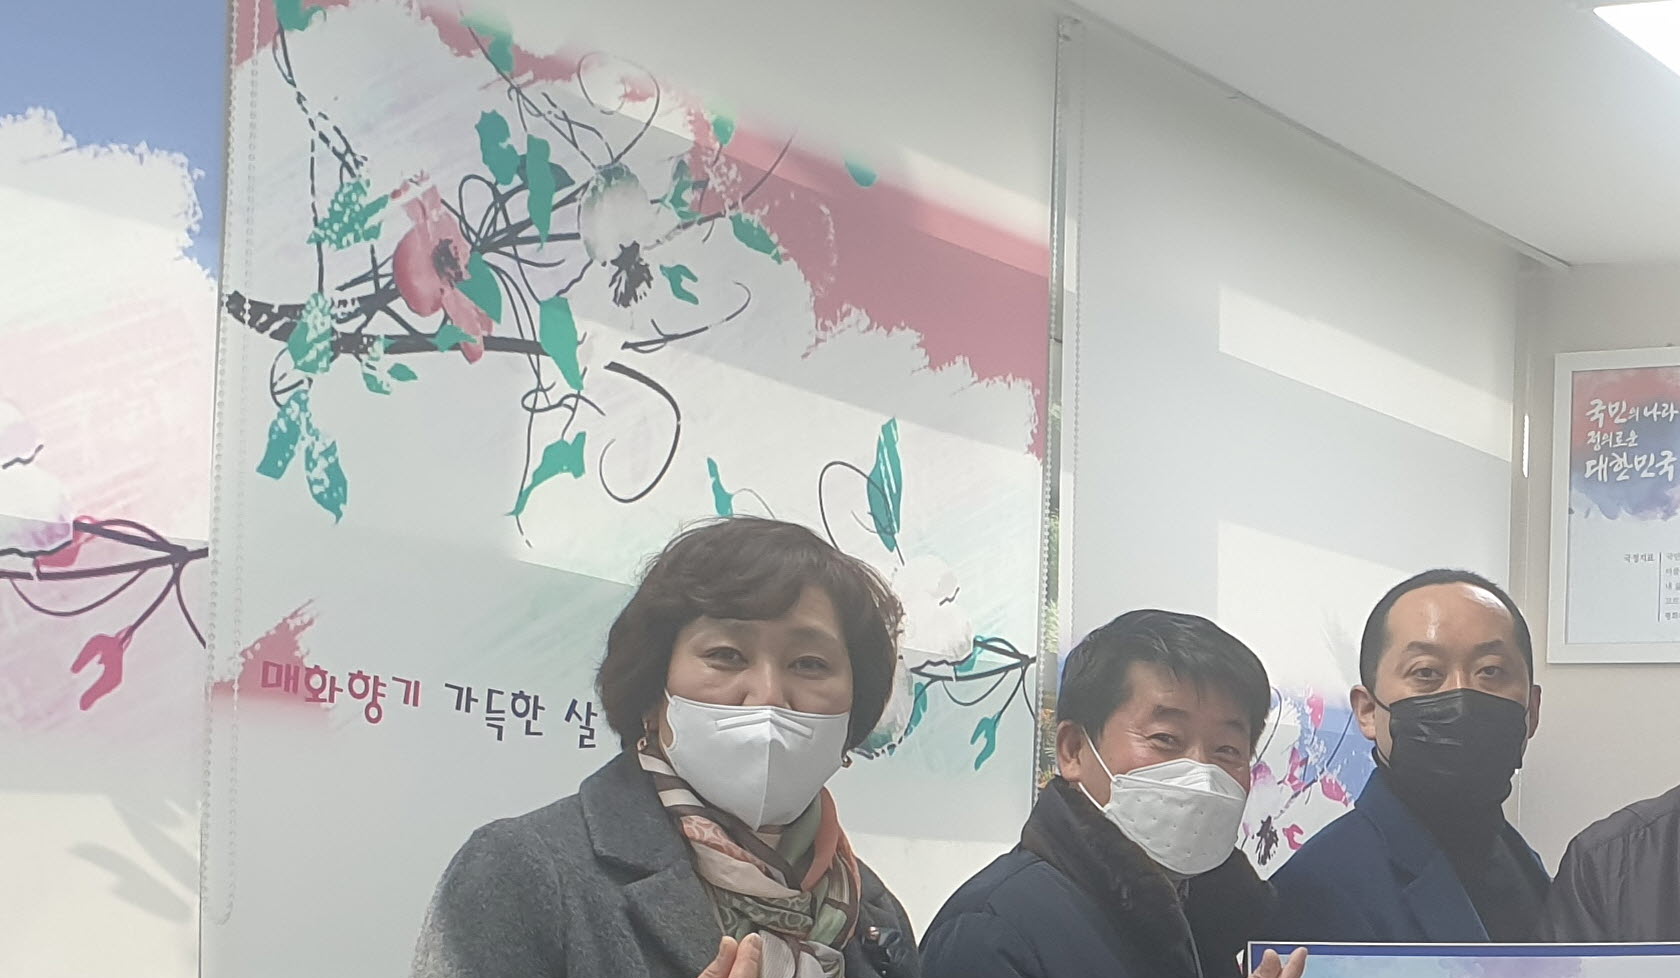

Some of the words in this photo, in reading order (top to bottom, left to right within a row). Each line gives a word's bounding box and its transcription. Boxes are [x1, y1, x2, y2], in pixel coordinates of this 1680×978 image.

[1585, 398, 1639, 428] 국민의
[1643, 402, 1679, 422] 나라
[1587, 429, 1638, 451] 정의로운
[1584, 450, 1678, 482] 대한민국
[261, 660, 421, 724] 매화향기
[444, 683, 546, 741] 가득한
